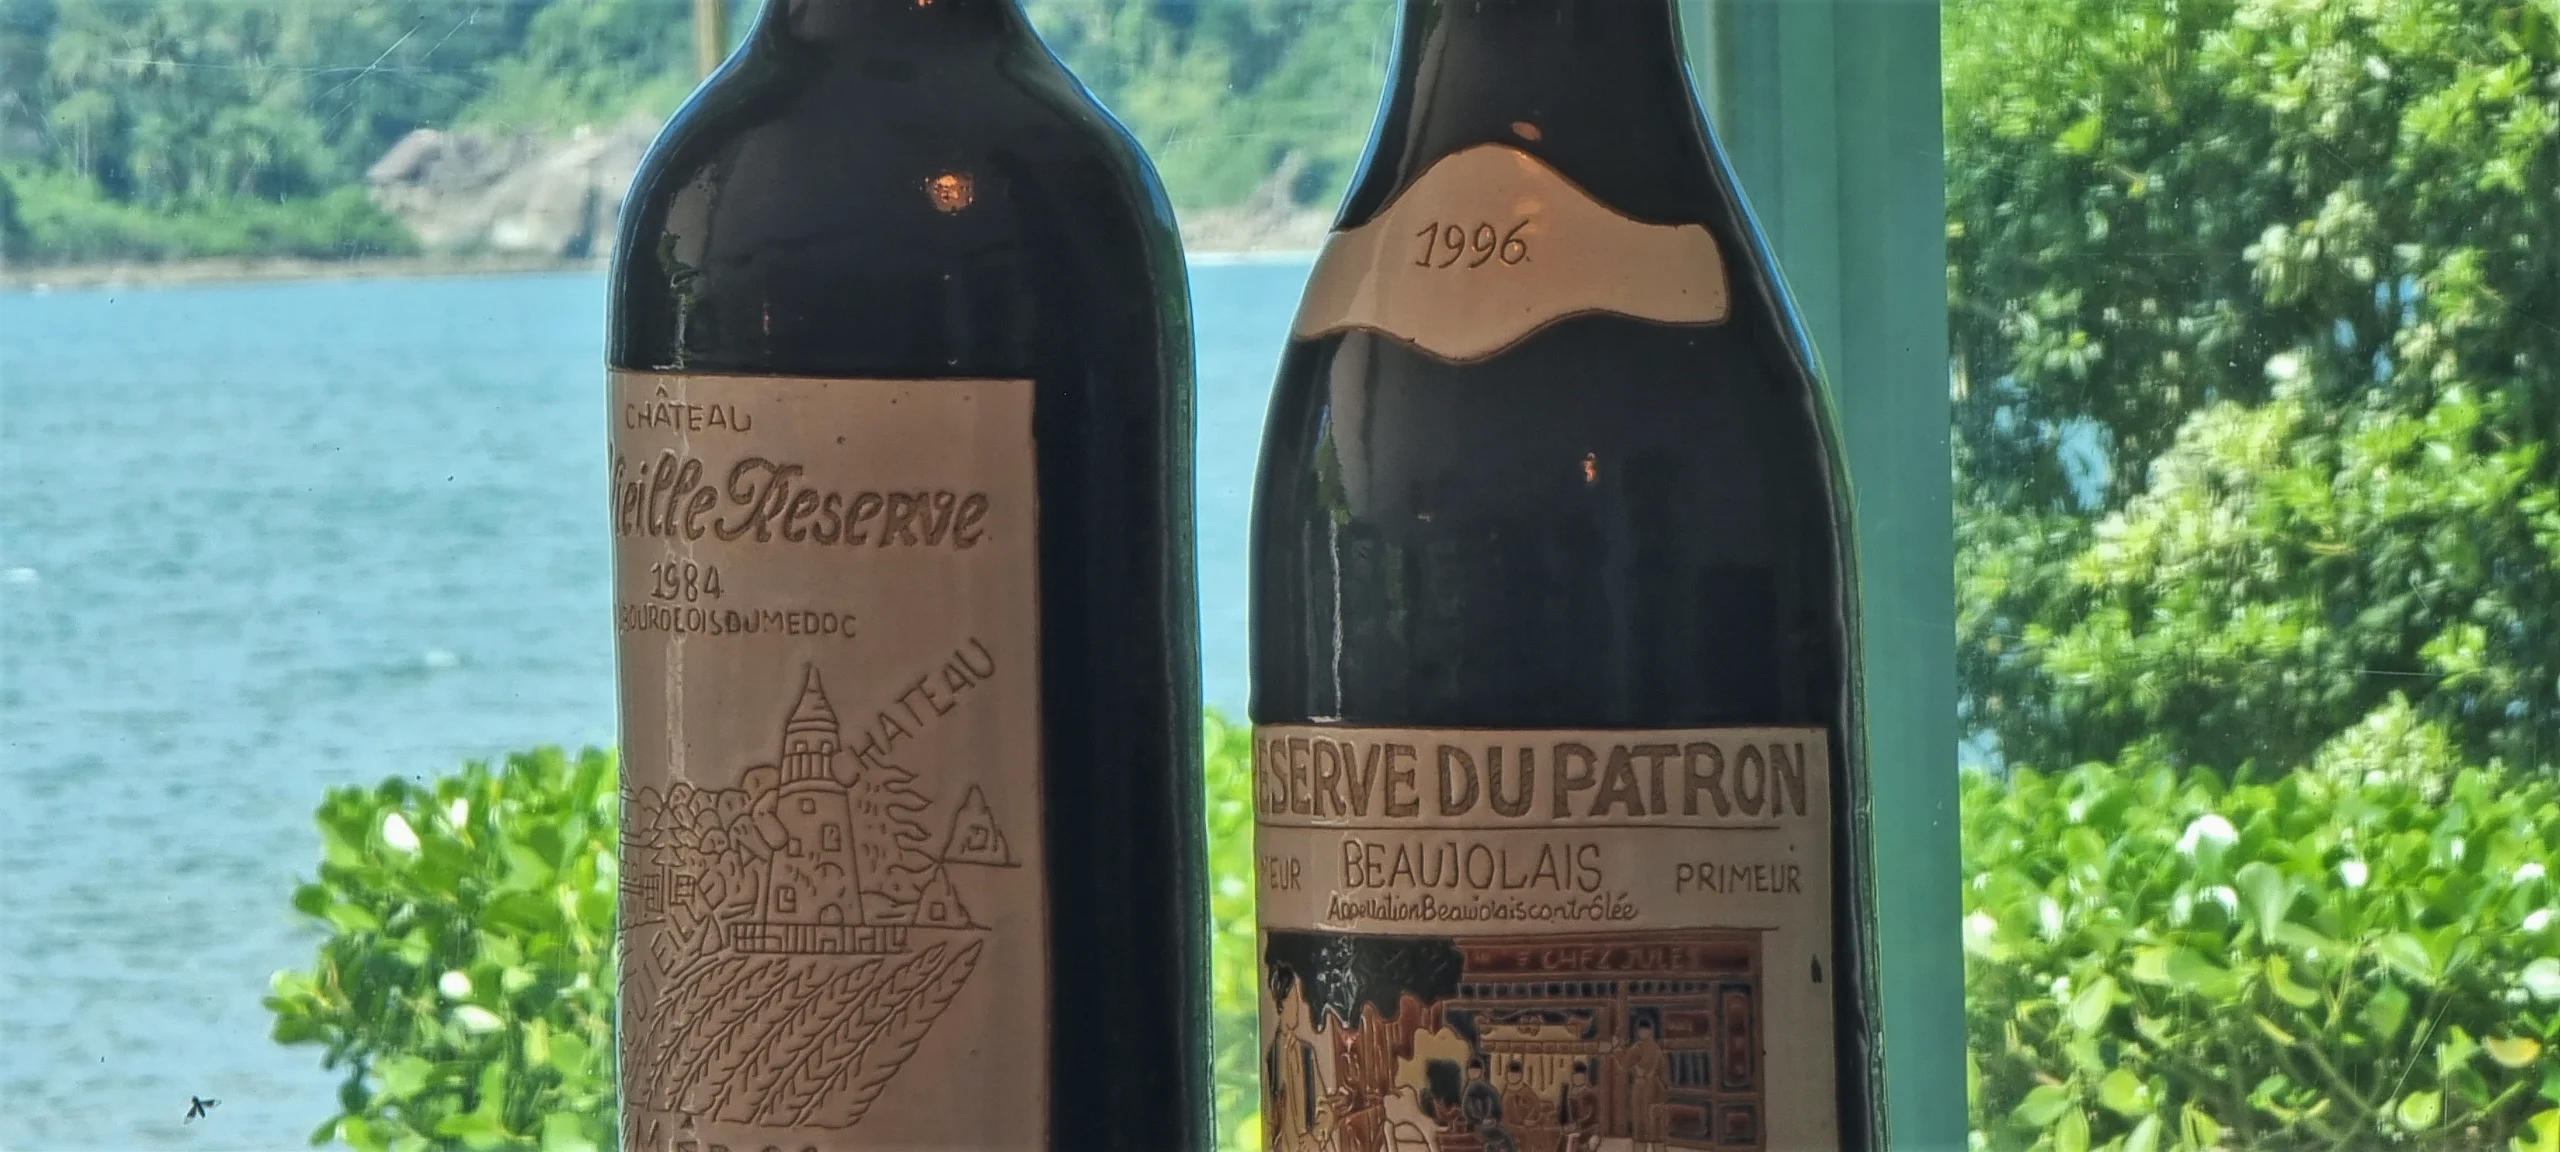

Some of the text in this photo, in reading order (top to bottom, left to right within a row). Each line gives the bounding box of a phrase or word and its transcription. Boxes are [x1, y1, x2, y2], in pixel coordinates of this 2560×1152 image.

[626, 385, 752, 432] CHÂTEAU
[610, 449, 720, 540] ieille
[651, 561, 724, 602] 1984
[829, 636, 998, 789] CHATEAU
[1437, 744, 1534, 818] DU
[1552, 742, 1807, 819] PATRON
[1343, 839, 1601, 893] BEAUJOLAIS
[1674, 862, 1801, 894] PRIMEUR
